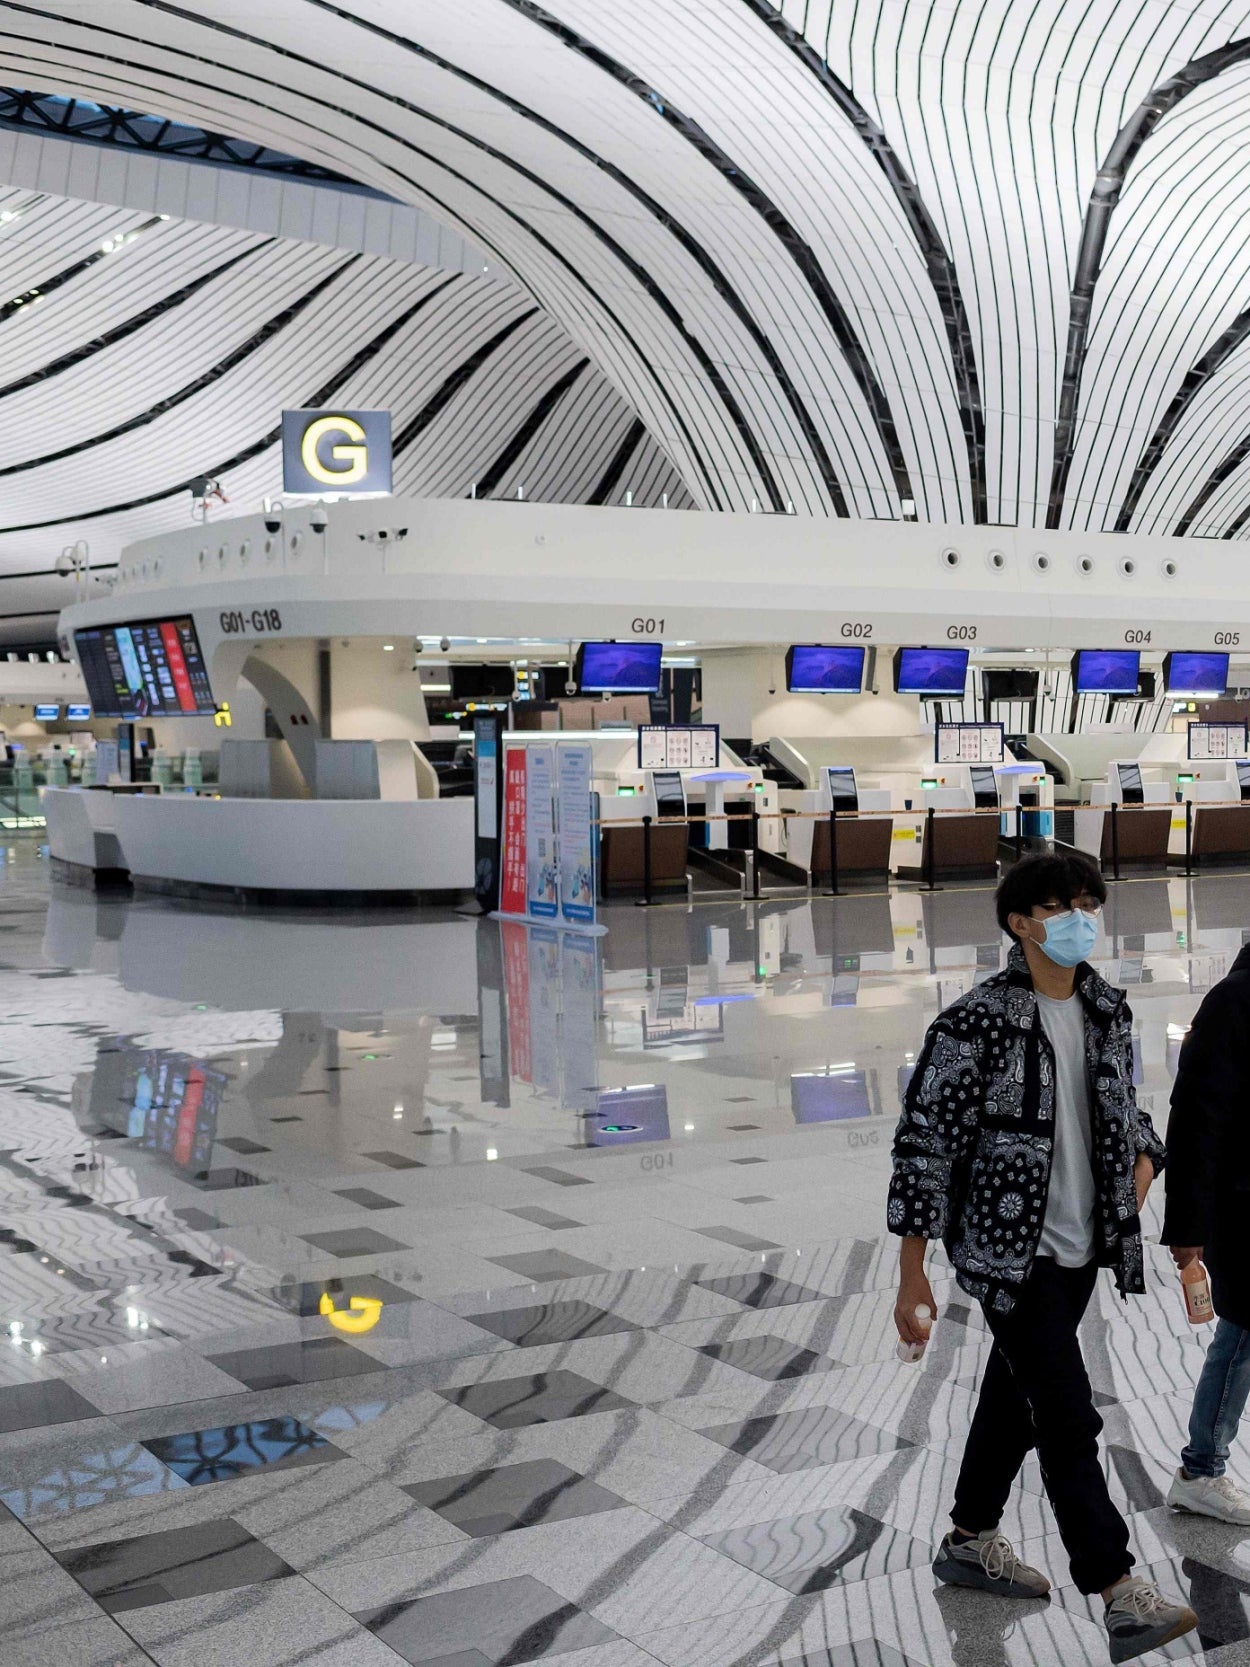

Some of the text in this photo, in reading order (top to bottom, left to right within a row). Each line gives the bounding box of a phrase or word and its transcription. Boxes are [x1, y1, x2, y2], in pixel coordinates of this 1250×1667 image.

[301, 415, 368, 486] G
[220, 608, 282, 633] G01-G18
[631, 617, 665, 634] G01
[840, 622, 873, 639] G02
[946, 625, 977, 640] G03
[1124, 629, 1152, 644] G04
[1214, 631, 1240, 646] G05
